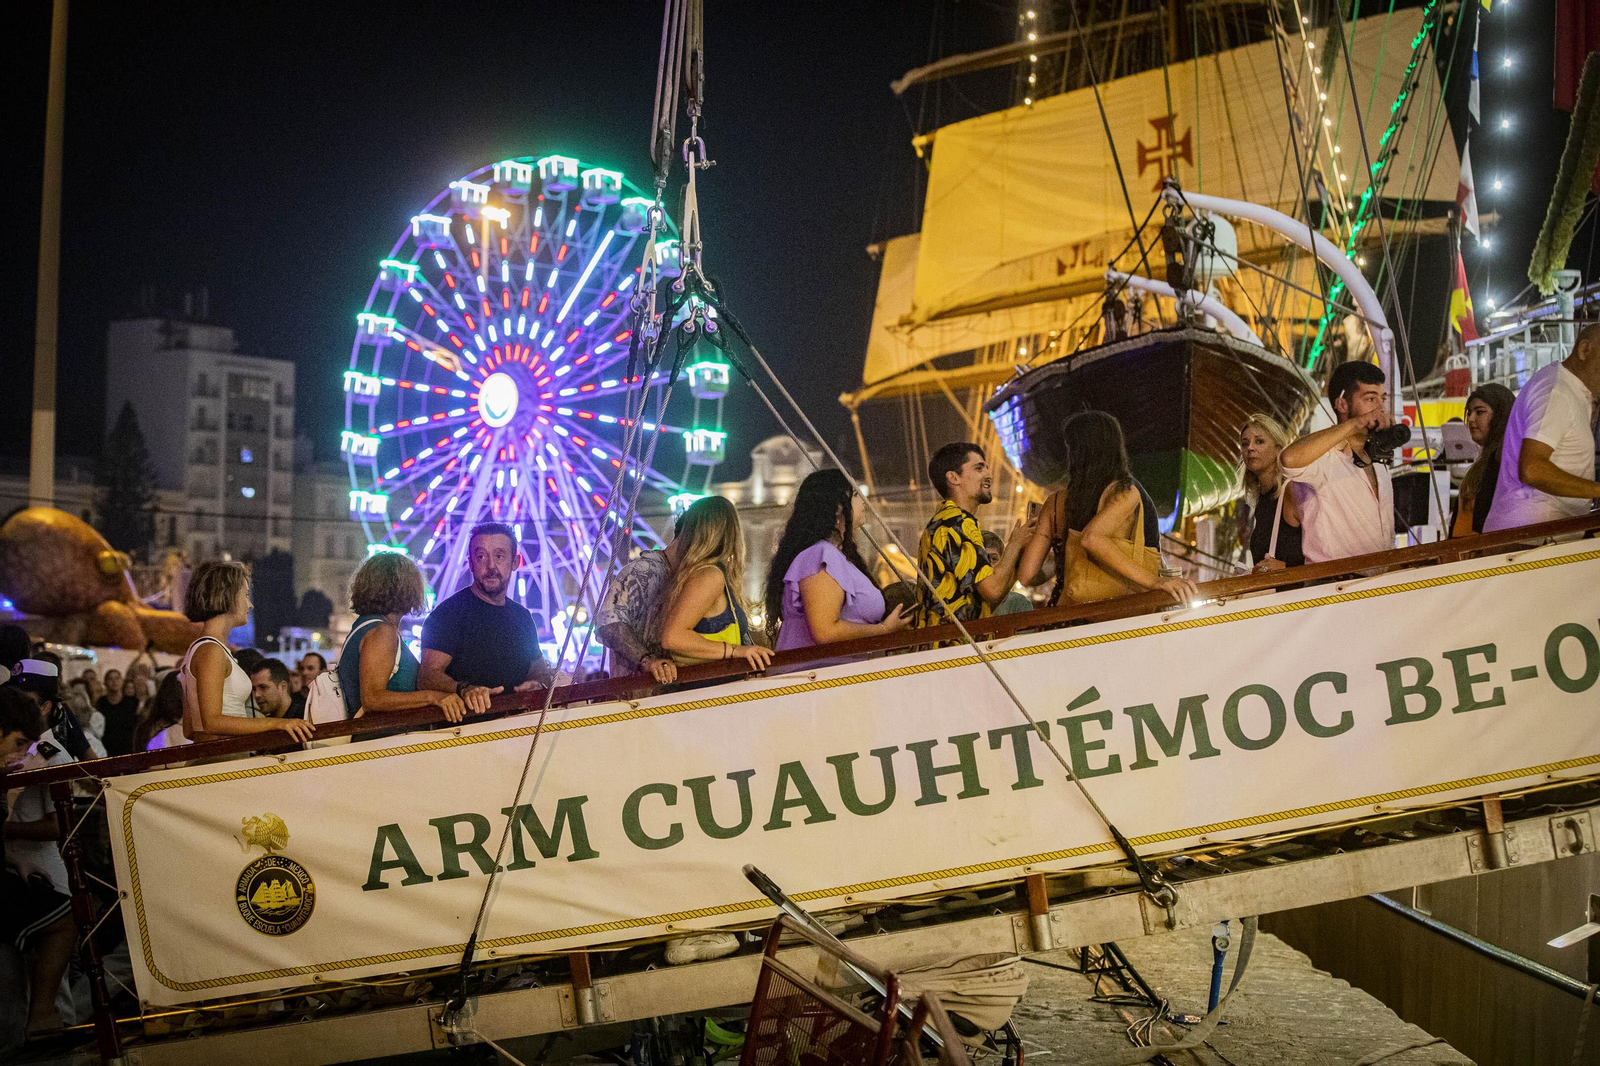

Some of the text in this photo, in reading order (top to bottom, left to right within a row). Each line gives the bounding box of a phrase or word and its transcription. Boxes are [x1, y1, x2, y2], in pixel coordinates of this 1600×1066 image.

[363, 617, 1600, 891] ARM CUAUHTÉMOC BE-0
[238, 866, 258, 893] ARMADA
[267, 858, 277, 866] DE
[239, 902, 256, 924] BUQUE
[253, 920, 282, 934] ESCUELA
